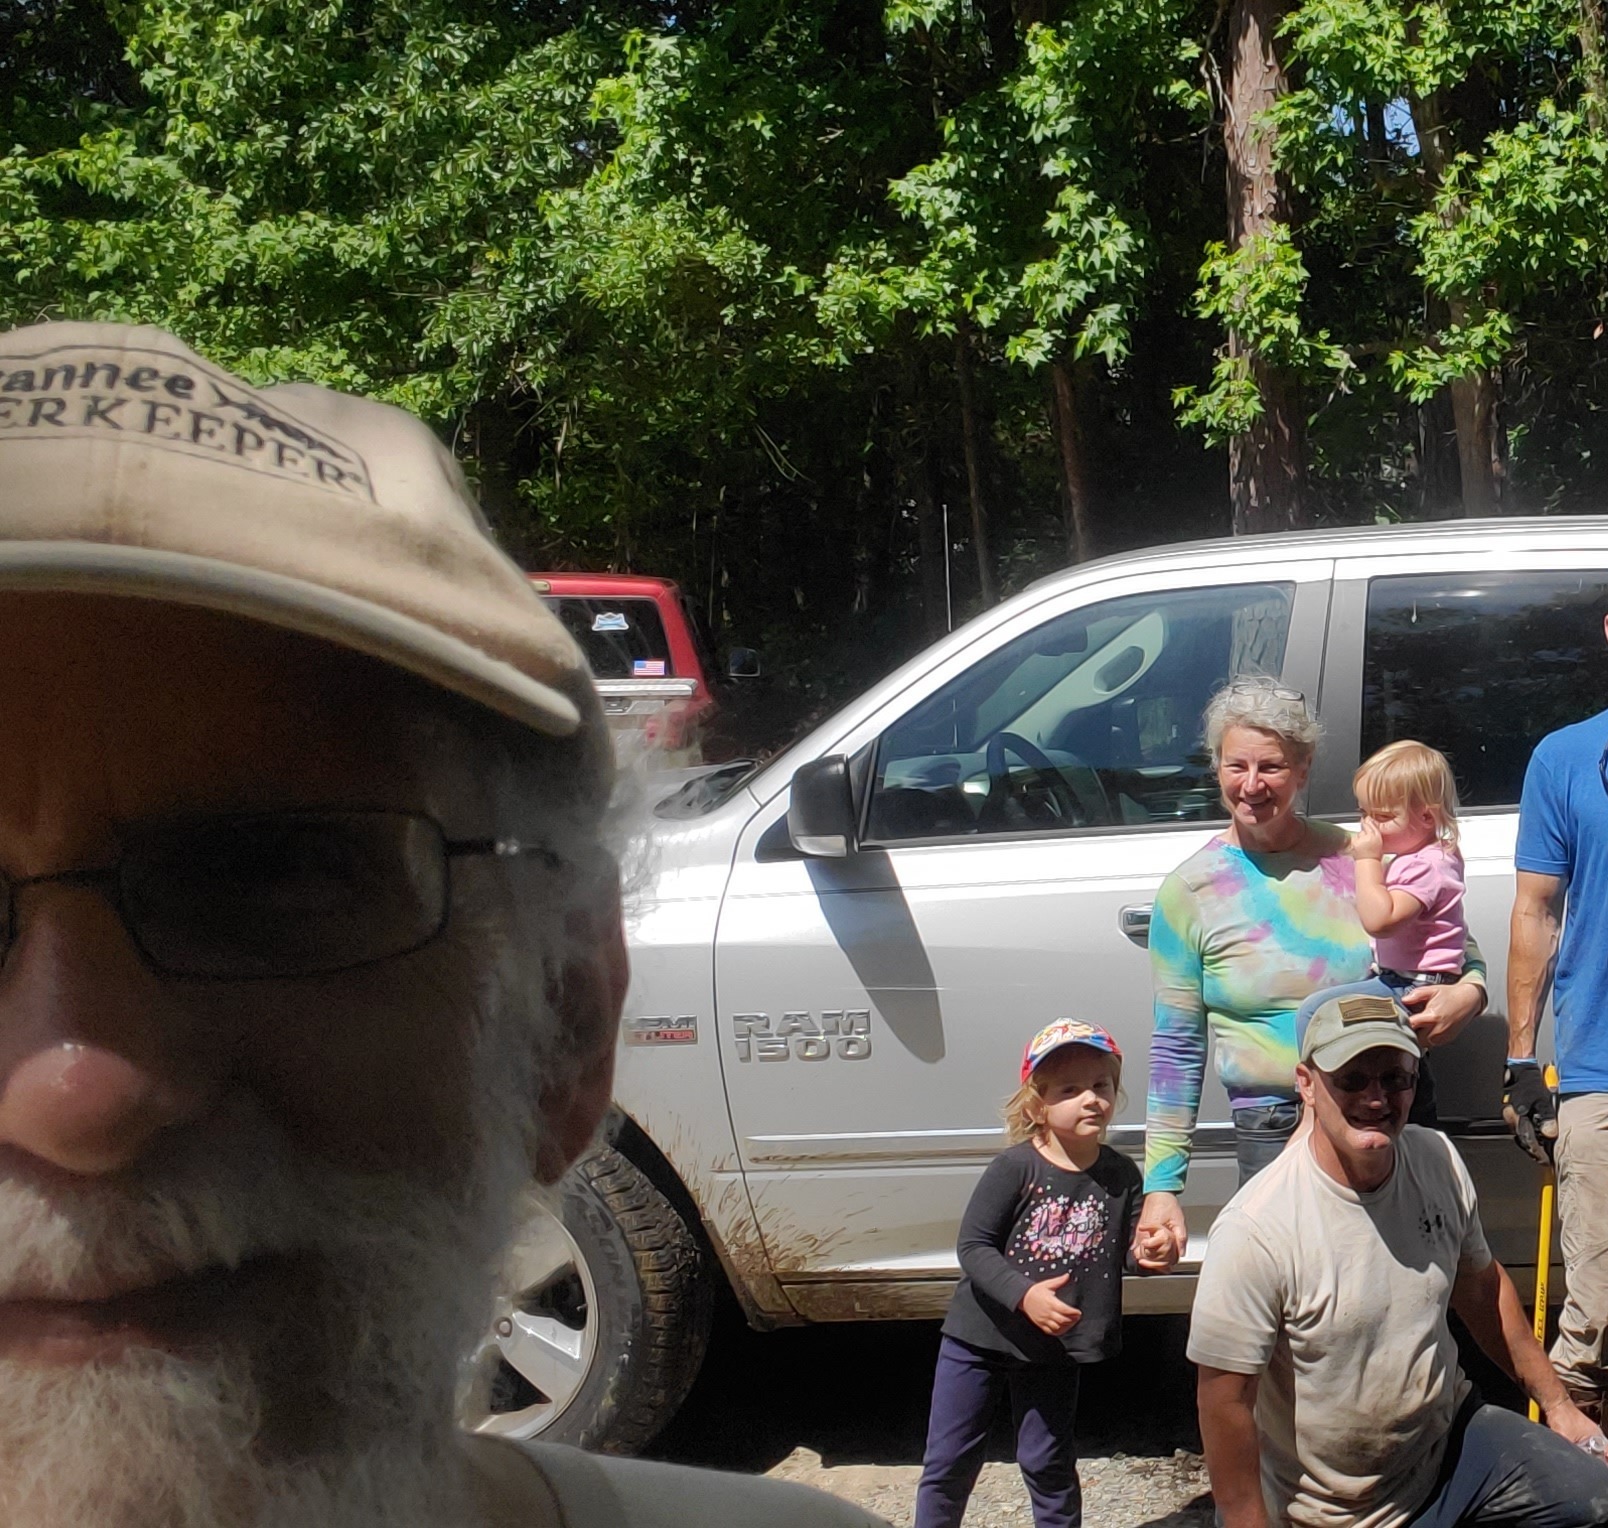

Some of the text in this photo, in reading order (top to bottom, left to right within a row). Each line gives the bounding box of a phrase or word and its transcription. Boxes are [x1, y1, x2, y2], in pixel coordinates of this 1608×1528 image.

[0, 361, 195, 400] annee
[733, 1010, 871, 1038] RAM
[734, 1036, 872, 1063] 1500
